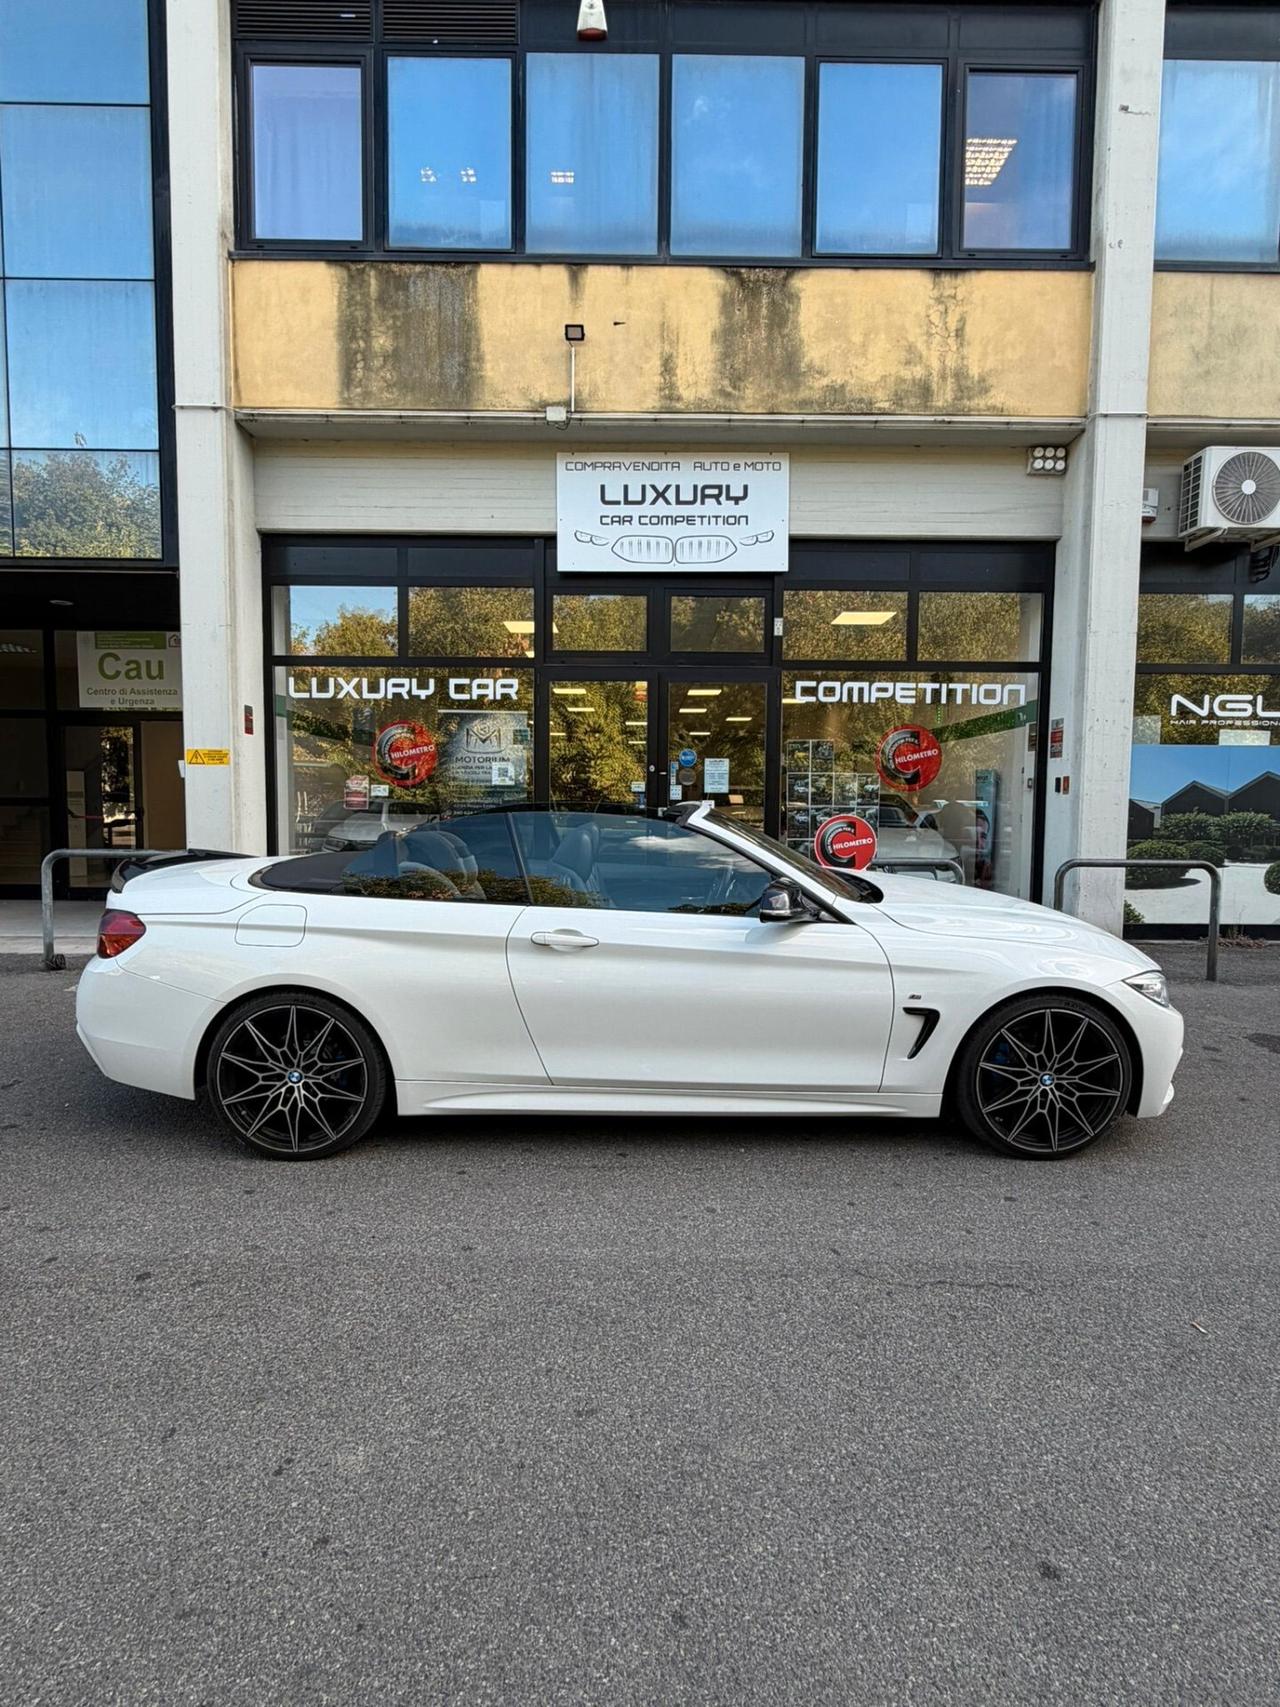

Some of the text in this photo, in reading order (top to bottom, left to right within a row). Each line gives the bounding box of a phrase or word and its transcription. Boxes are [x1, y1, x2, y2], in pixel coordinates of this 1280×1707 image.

[565, 461, 782, 472] COMPRAVENDITA AUTO e MOTO
[599, 484, 749, 506] LUXURY
[599, 515, 749, 526] CAR COMPETITION
[98, 652, 164, 680] Cau
[87, 687, 178, 696] Centro di Assistenza
[288, 677, 519, 701] LUXURY CAR
[795, 681, 1026, 706] COMPETITION
[118, 697, 155, 706] Urgenza
[1201, 719, 1280, 727] PROFESSION
